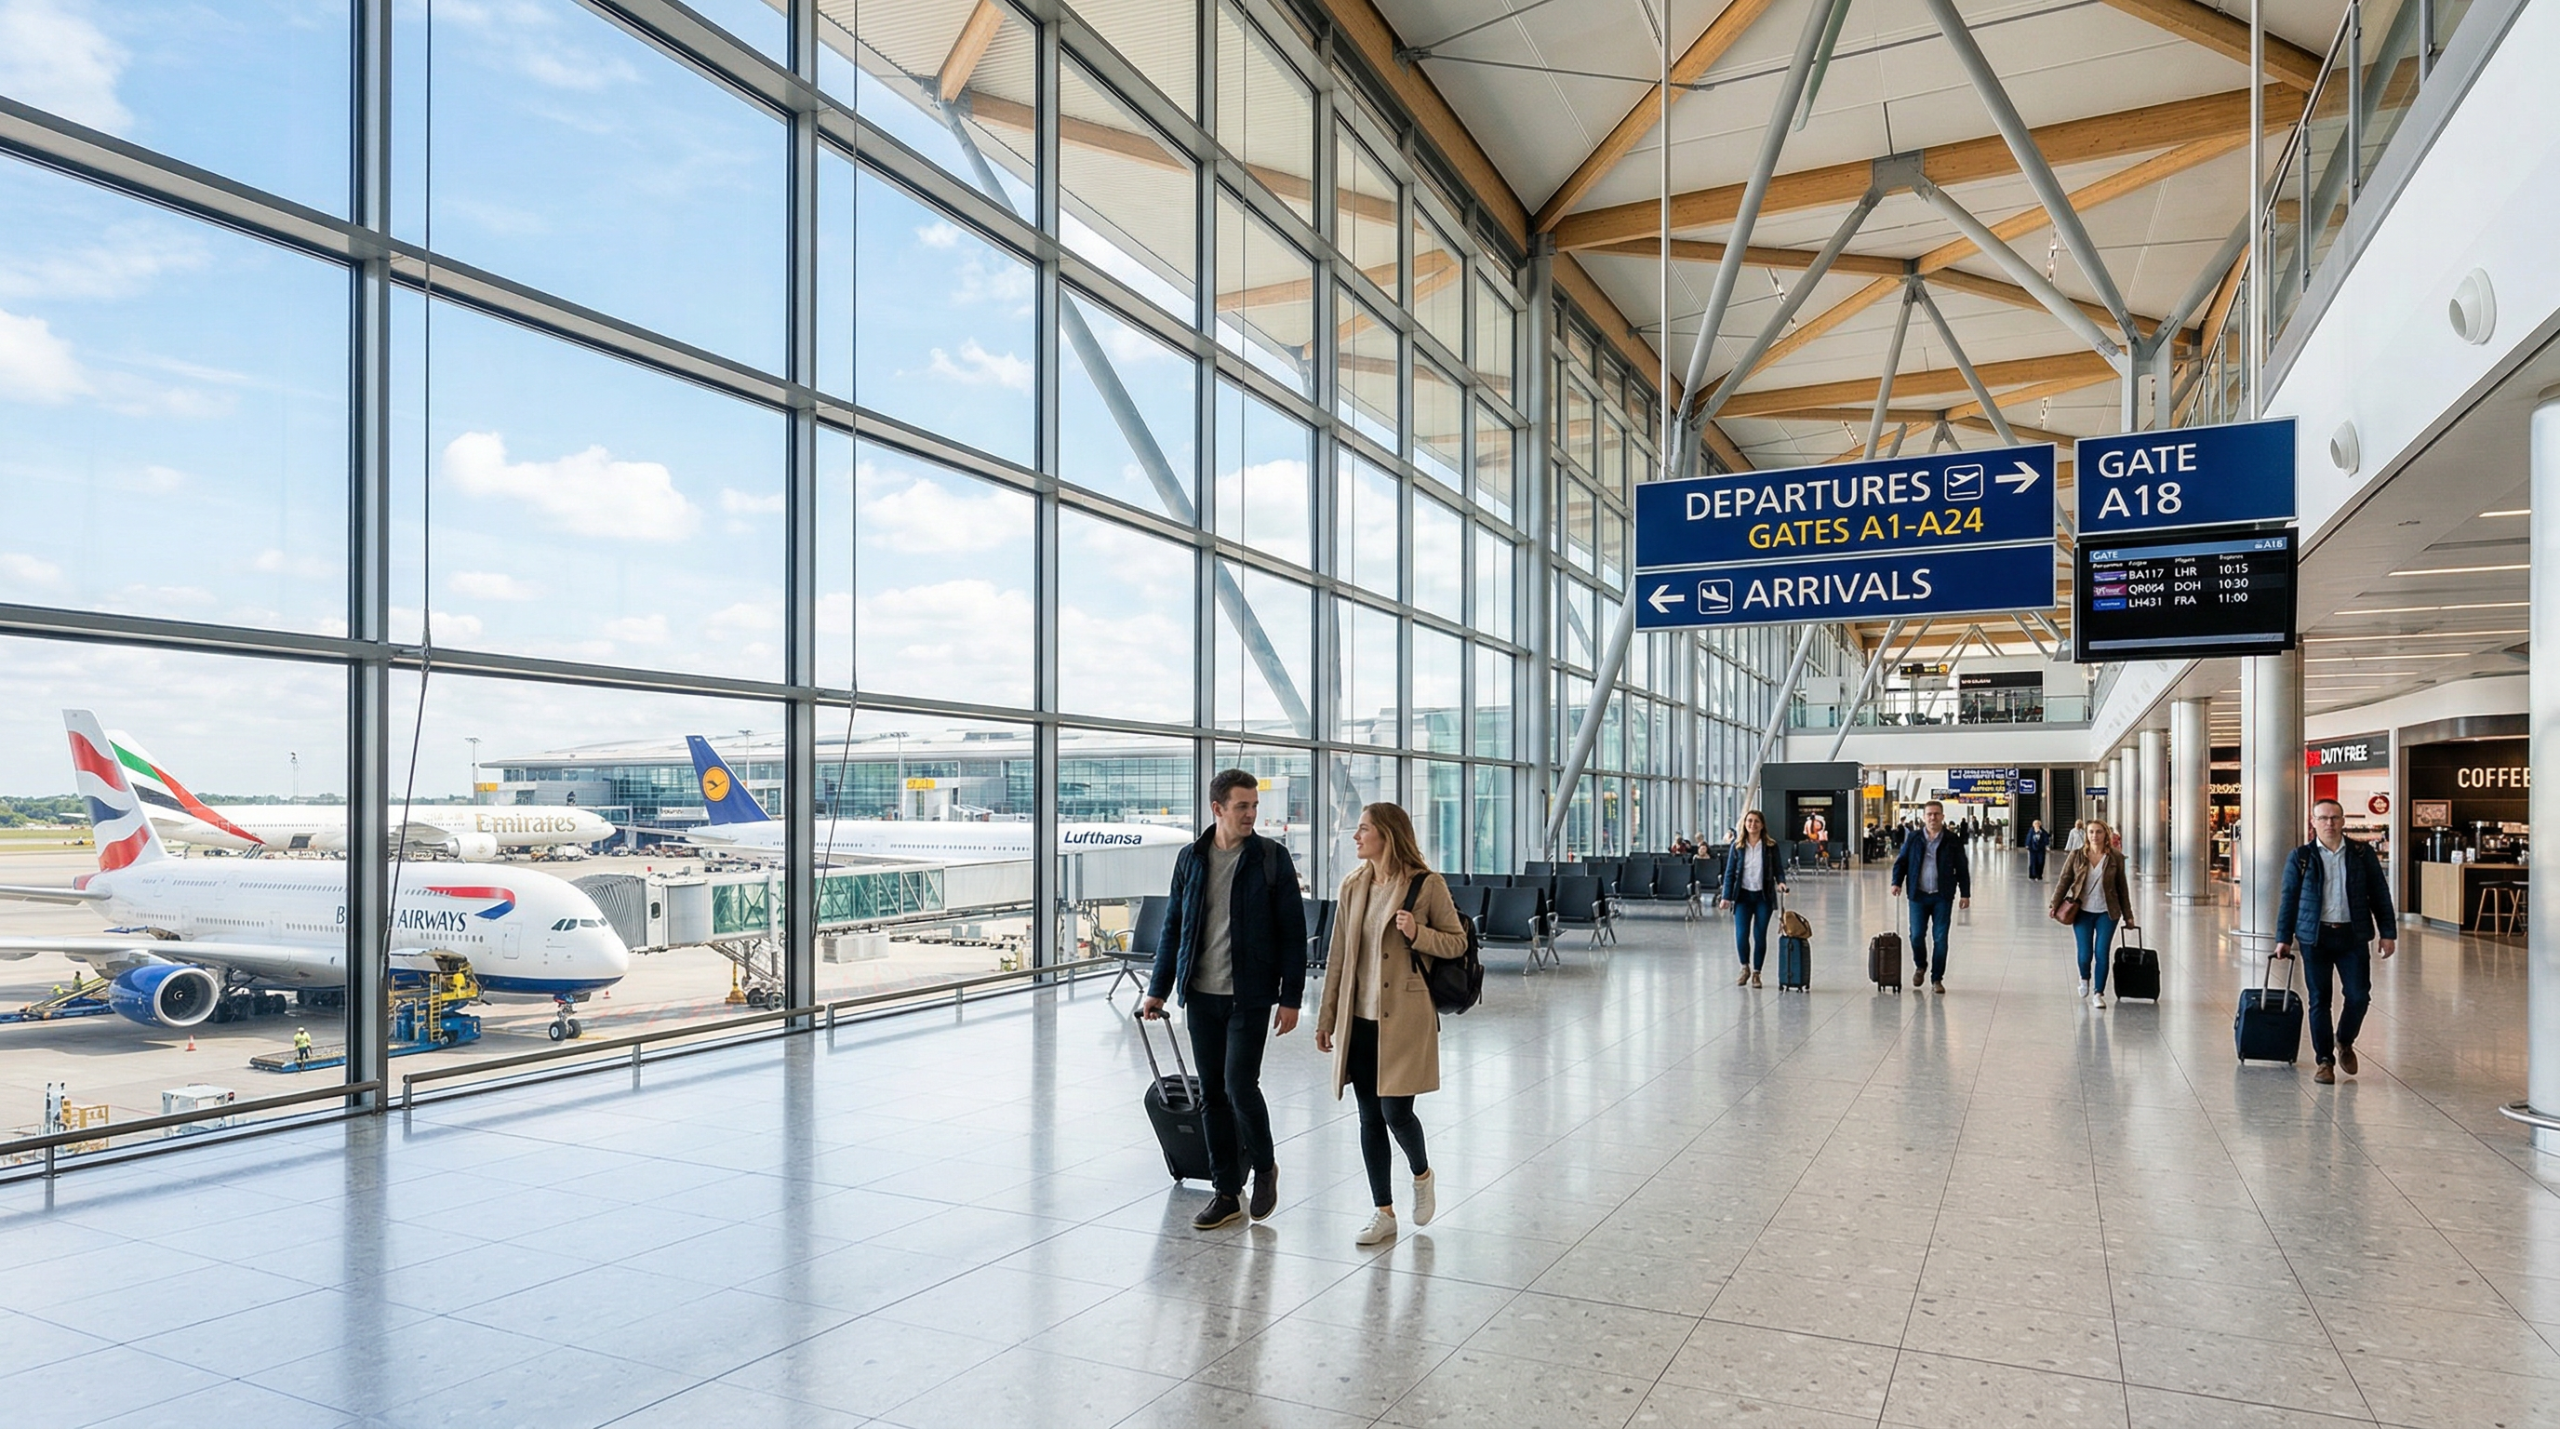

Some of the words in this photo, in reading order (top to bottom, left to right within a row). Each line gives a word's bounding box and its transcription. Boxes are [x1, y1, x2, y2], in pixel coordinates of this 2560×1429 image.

[2098, 443, 2197, 478] GATE
[1686, 471, 1931, 521] DEPARTURES
[2098, 482, 2182, 519] A18
[1749, 518, 1850, 549] GATES
[1860, 507, 1984, 542] A1-A24
[2093, 551, 2118, 560] GATE
[2129, 568, 2164, 580] BA117
[2175, 566, 2197, 577] LHR
[2219, 563, 2248, 574] 10:15
[1742, 568, 1932, 610] ARRIVALS
[2174, 580, 2201, 592] DOH
[2219, 578, 2248, 589] 10:30
[2129, 597, 2162, 608] LH431
[2174, 595, 2197, 606] FRA
[2219, 592, 2248, 603] 11:00
[2321, 747, 2343, 765] DUTY
[2344, 744, 2368, 762] FREE
[2457, 767, 2530, 788] COFFEE
[475, 813, 577, 833] Emirates
[1064, 831, 1142, 845] Lufthansa
[397, 909, 467, 932] AIRWAYS
